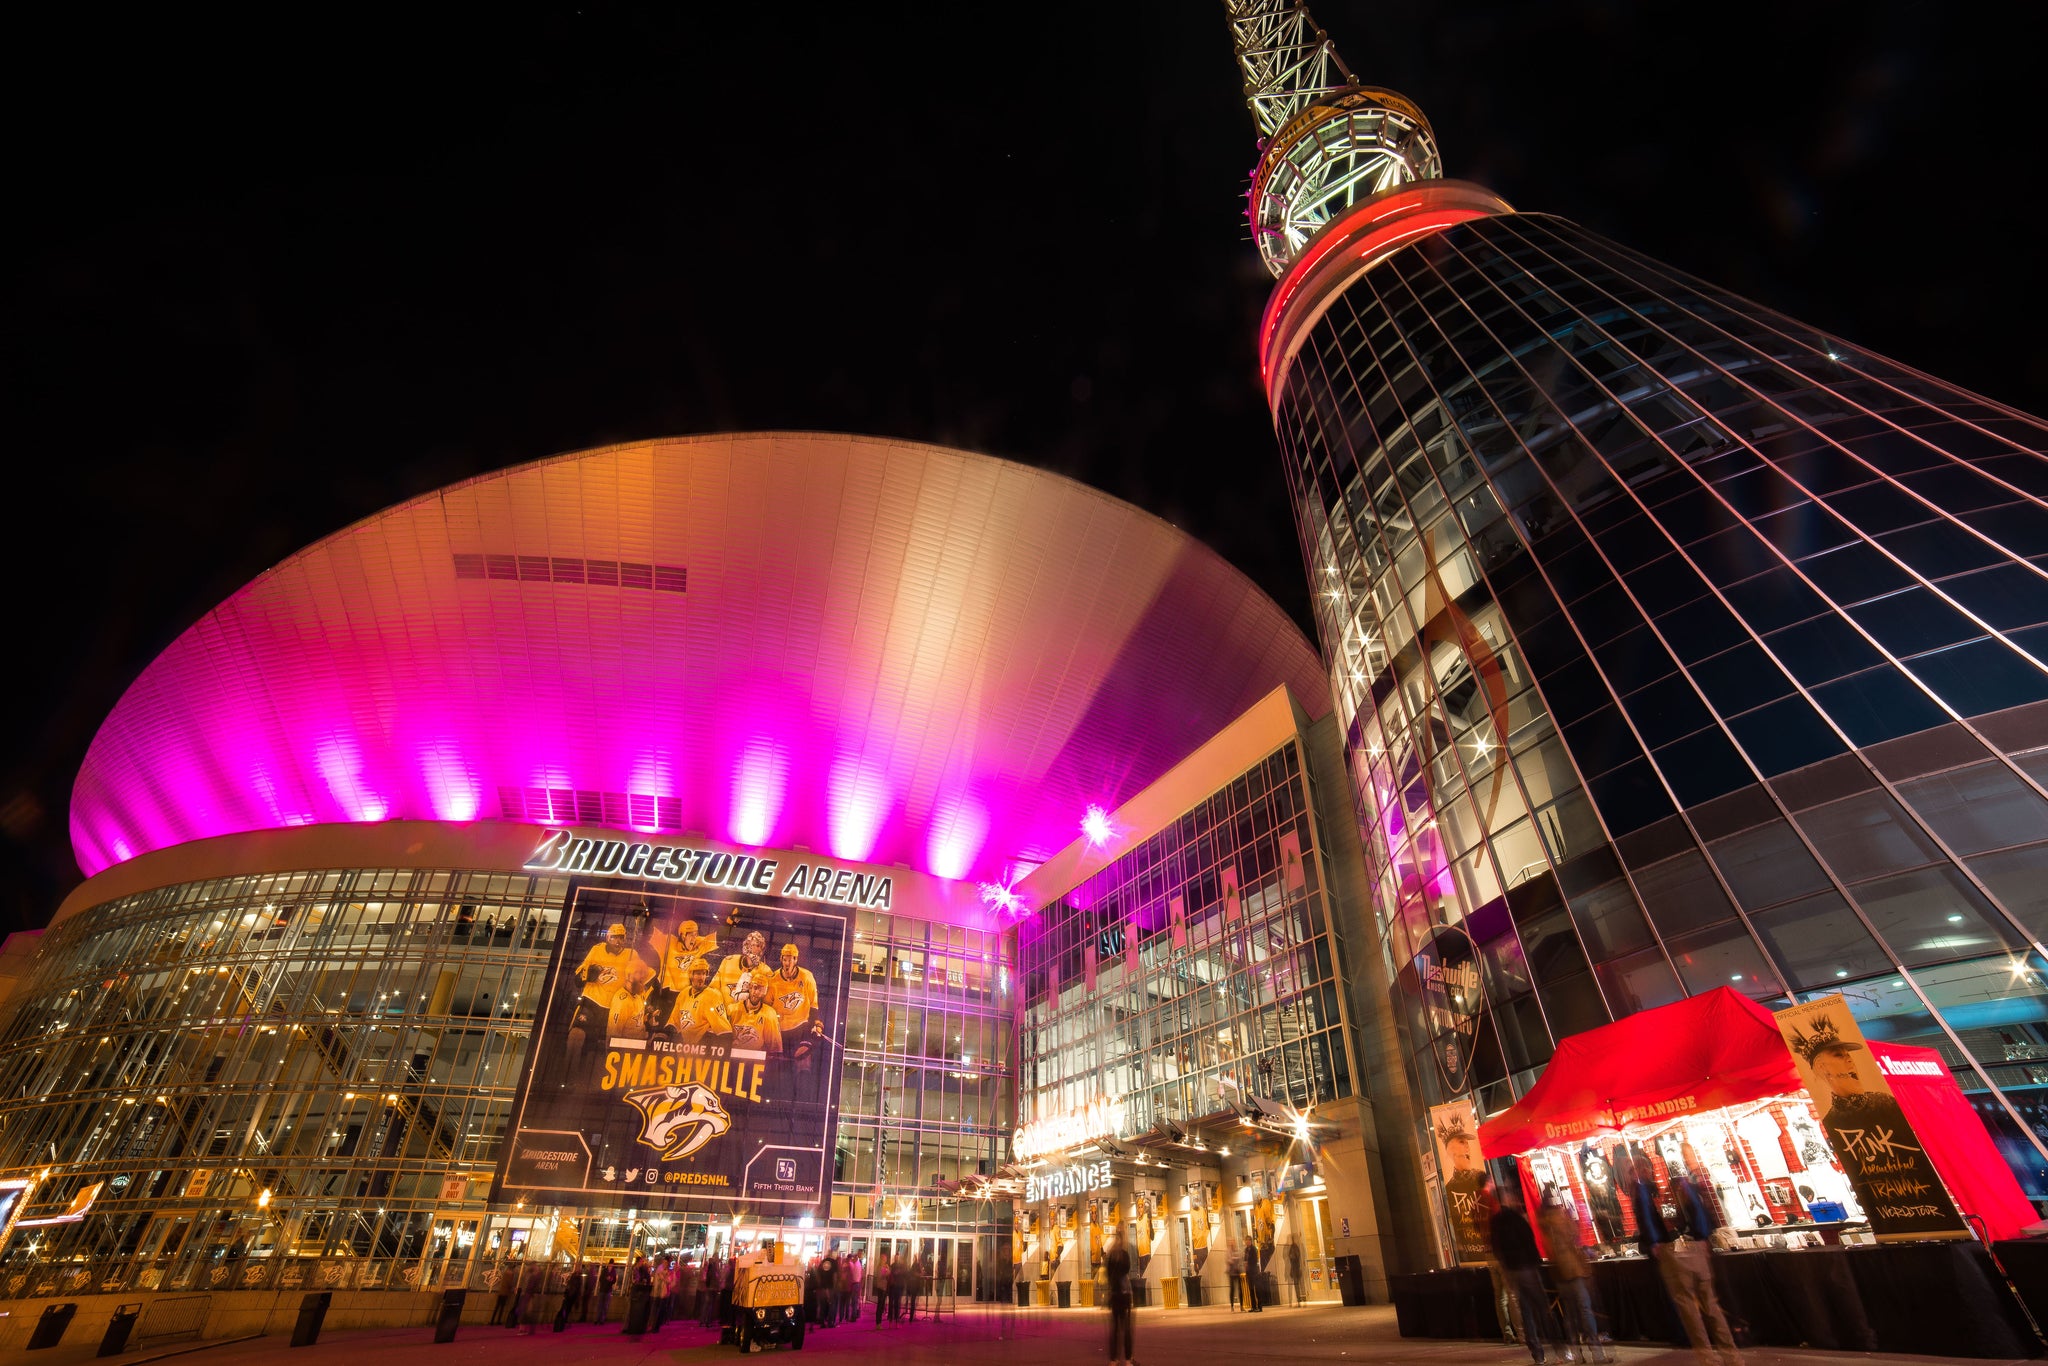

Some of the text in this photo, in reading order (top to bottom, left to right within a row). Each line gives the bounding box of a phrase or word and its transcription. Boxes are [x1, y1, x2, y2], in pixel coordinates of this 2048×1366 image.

[523, 829, 894, 910] BRIDGESTONE ARENA
[1776, 997, 1842, 1020] OFFICIAL MERCHANDISE
[653, 1040, 725, 1057] WELCOME TO
[601, 1051, 765, 1103] SMASHVILLE
[1545, 1095, 1697, 1139] OFFICIAL MERCHANDISE
[520, 1149, 578, 1162] BRIDGESTONE
[535, 1161, 559, 1170] ARENA
[664, 1171, 730, 1187] @PREDSNHL
[754, 1182, 814, 1192] FIFTH THIRD BANK
[1026, 1160, 1112, 1204] ENTRANCE
[1857, 1177, 1931, 1200] TRAUMA
